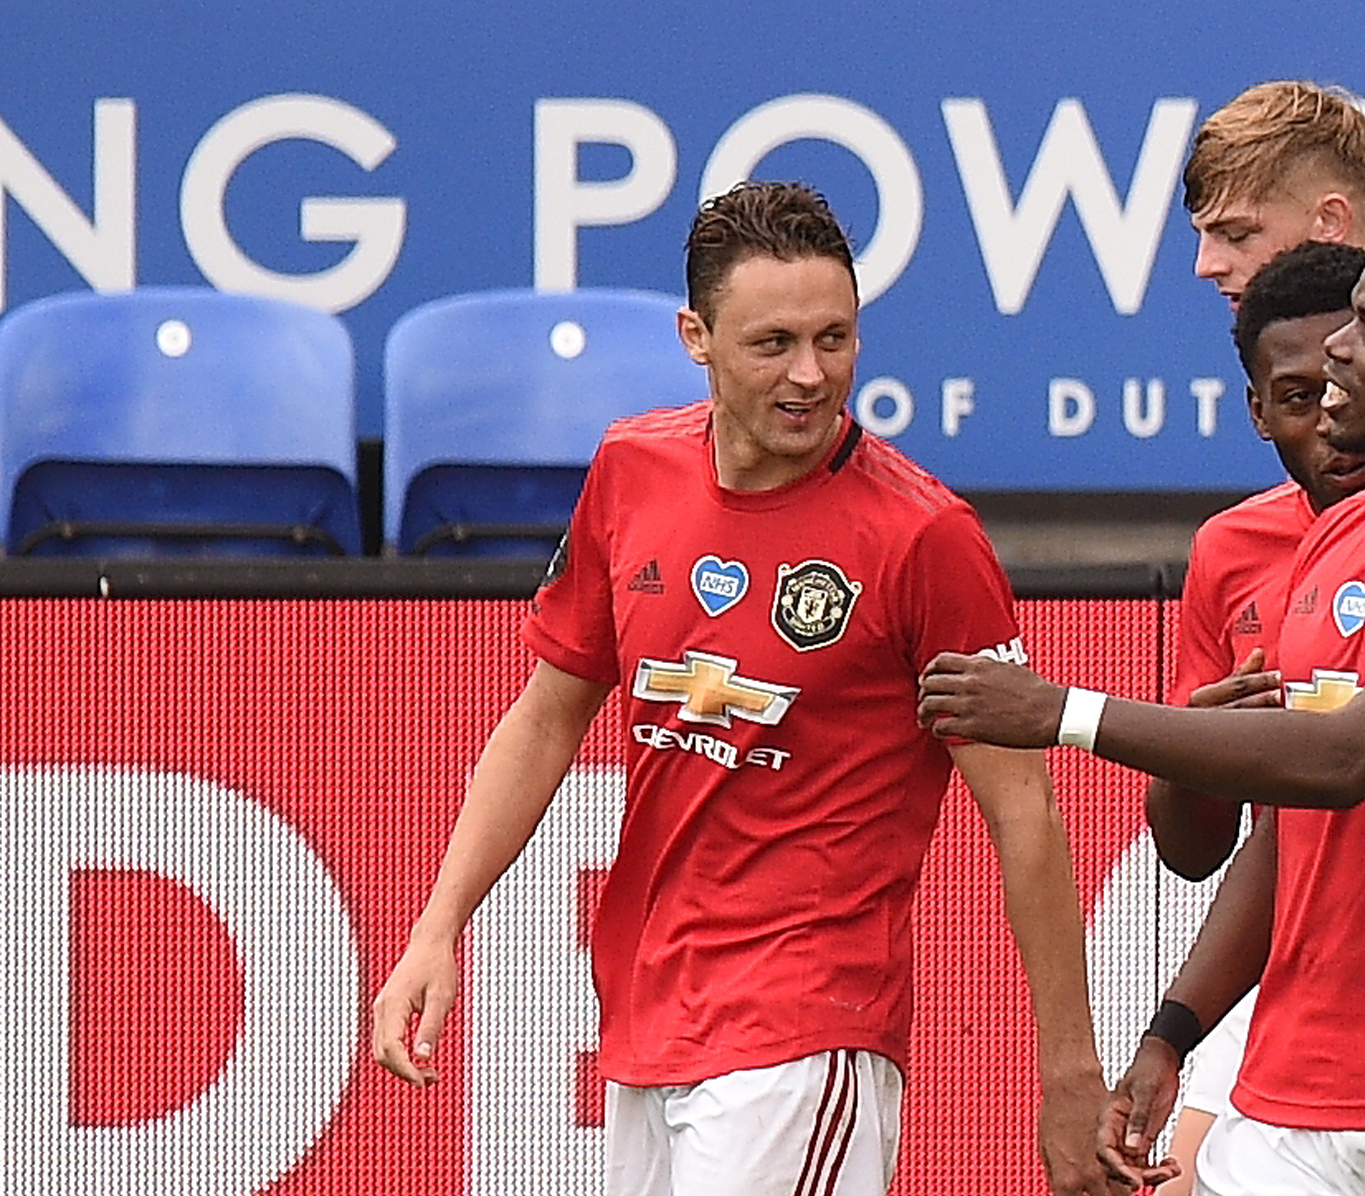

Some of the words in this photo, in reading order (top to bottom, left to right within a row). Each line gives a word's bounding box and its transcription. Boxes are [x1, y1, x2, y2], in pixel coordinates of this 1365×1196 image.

[857, 378, 975, 437] OF
[1048, 378, 1225, 437] DUT
[702, 577, 736, 594] NHS
